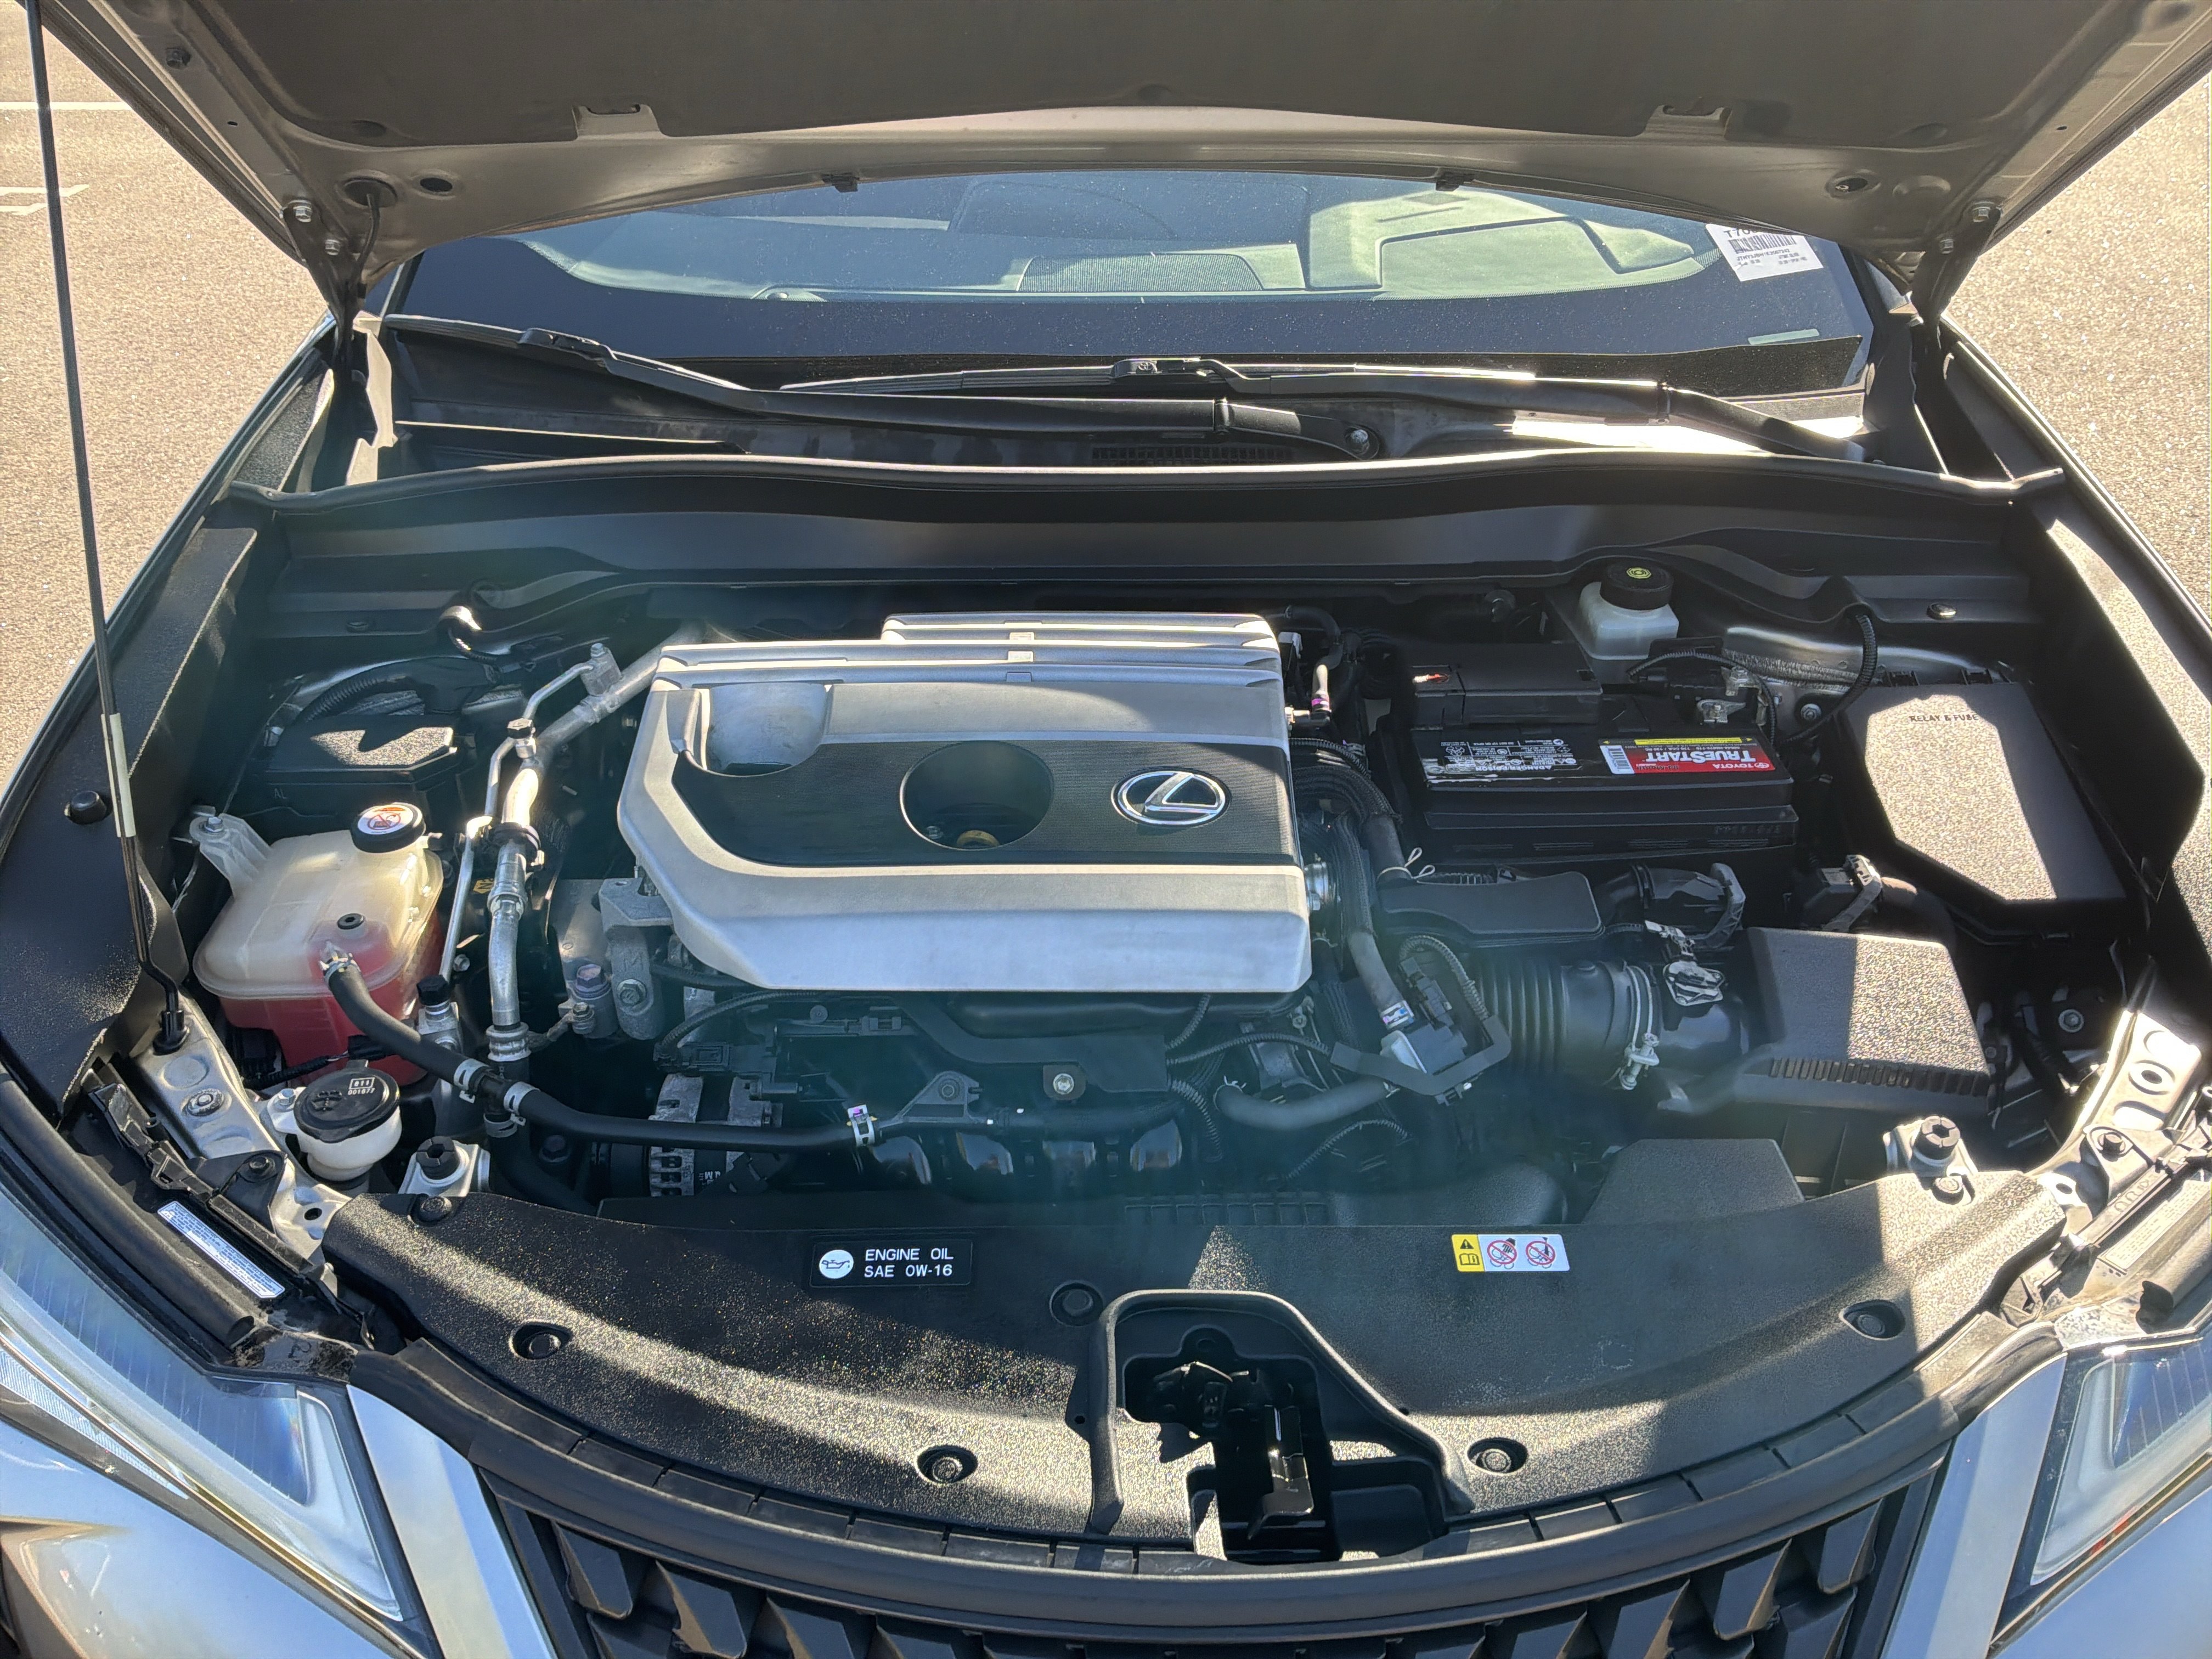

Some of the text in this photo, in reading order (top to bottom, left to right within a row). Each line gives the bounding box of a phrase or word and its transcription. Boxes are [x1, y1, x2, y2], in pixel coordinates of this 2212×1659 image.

[865, 1248, 954, 1261] ENGINE OIL
[864, 1264, 952, 1278] SAE 0W-16
